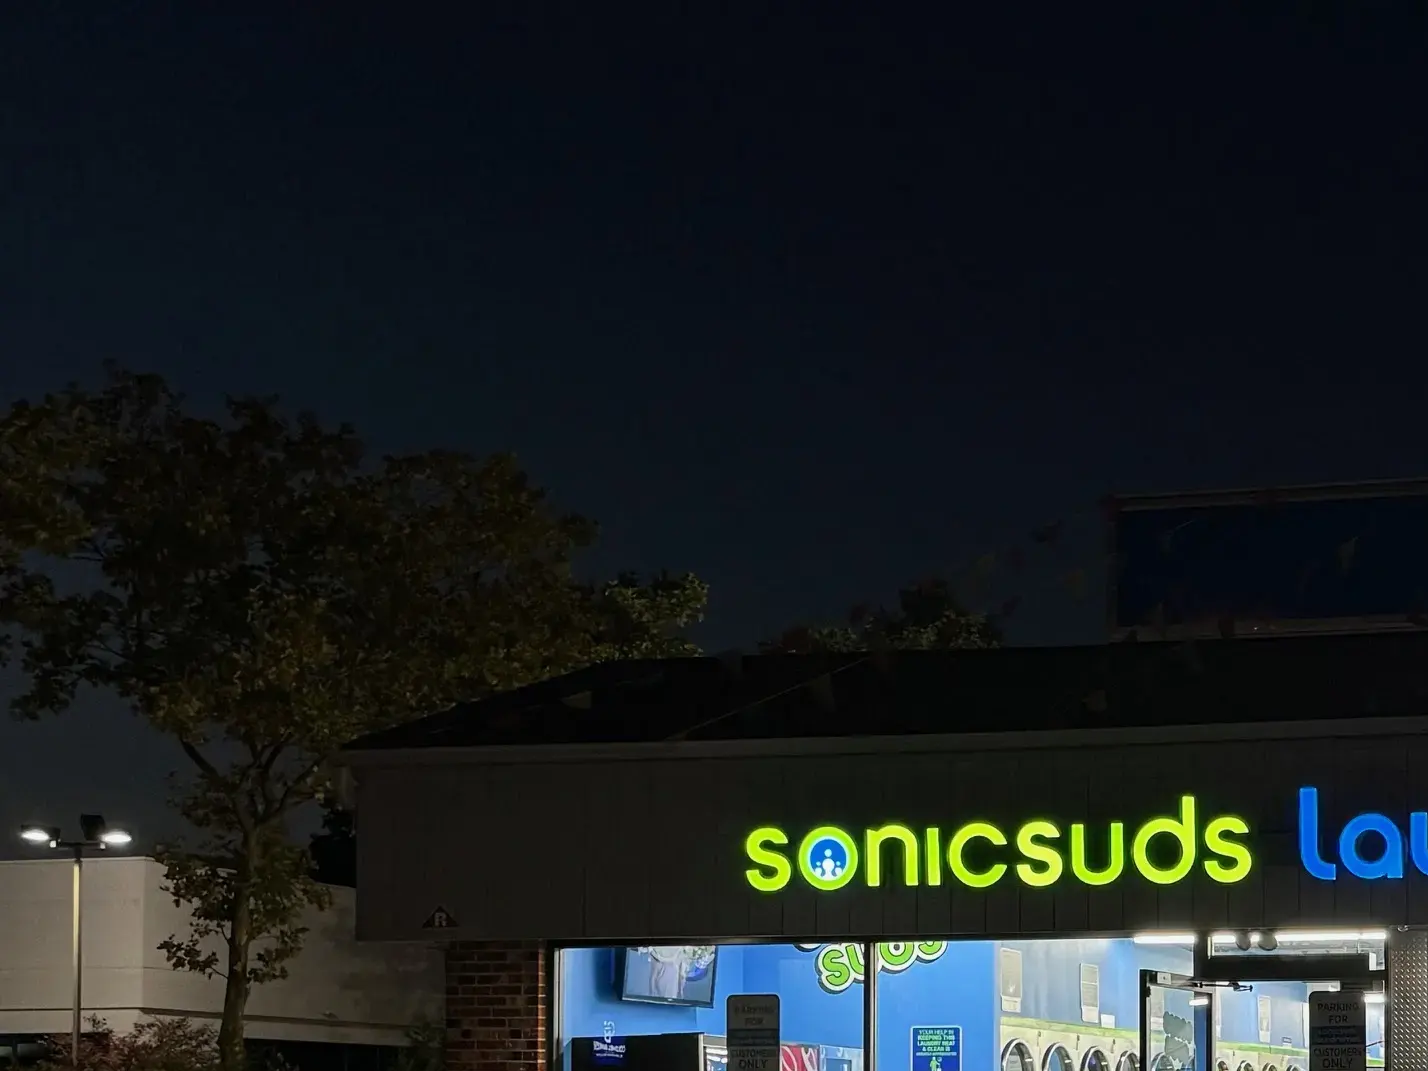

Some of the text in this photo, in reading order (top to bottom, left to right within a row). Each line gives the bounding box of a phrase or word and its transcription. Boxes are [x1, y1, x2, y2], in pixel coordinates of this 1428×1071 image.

[745, 796, 1253, 892] sonicsuds
[1317, 1002, 1360, 1012] PARKING
[1328, 1014, 1348, 1024] FOR
[730, 1048, 777, 1058] CUSTOME
[1313, 1047, 1362, 1057] CUSTOMERS
[739, 1060, 768, 1070] ONLY
[1322, 1058, 1353, 1069] ONLY
